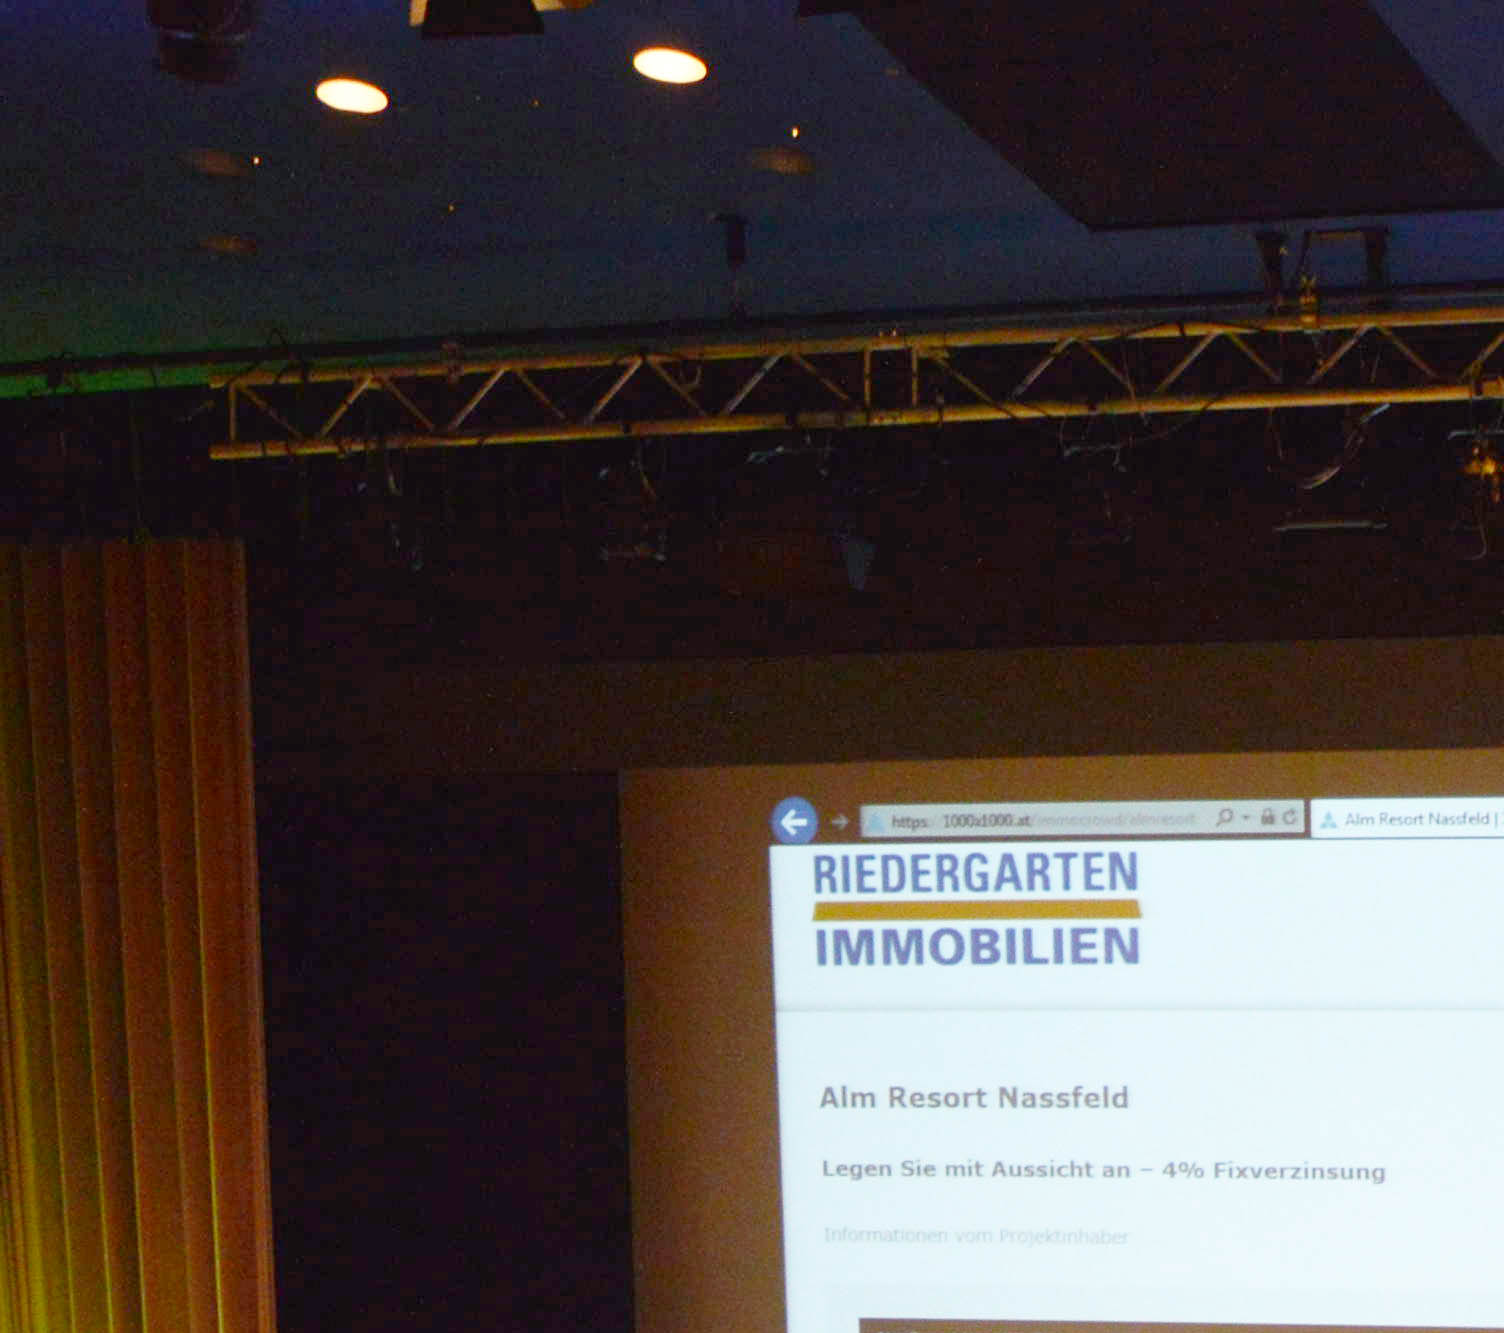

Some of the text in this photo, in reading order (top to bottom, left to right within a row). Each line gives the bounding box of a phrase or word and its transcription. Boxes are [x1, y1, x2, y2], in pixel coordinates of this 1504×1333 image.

[1345, 811, 1375, 826] Alm
[1380, 811, 1424, 826] Resort
[1429, 811, 1490, 826] Nassfeld
[813, 851, 1139, 895] RIEDERGARTEN
[815, 926, 1141, 967] IMMOBILIEN
[820, 1085, 1129, 1110] Alm Resort Nassfeld
[822, 1160, 893, 1182] Legen
[900, 1160, 937, 1179] Sie
[944, 1160, 984, 1179] mit
[991, 1160, 1094, 1180] Aussicht
[1102, 1164, 1131, 1180] an
[1162, 1162, 1205, 1181] 4%
[1213, 1162, 1387, 1186] Fixverzinsung
[824, 1226, 1131, 1247] Informationen vom Projektinhaber
